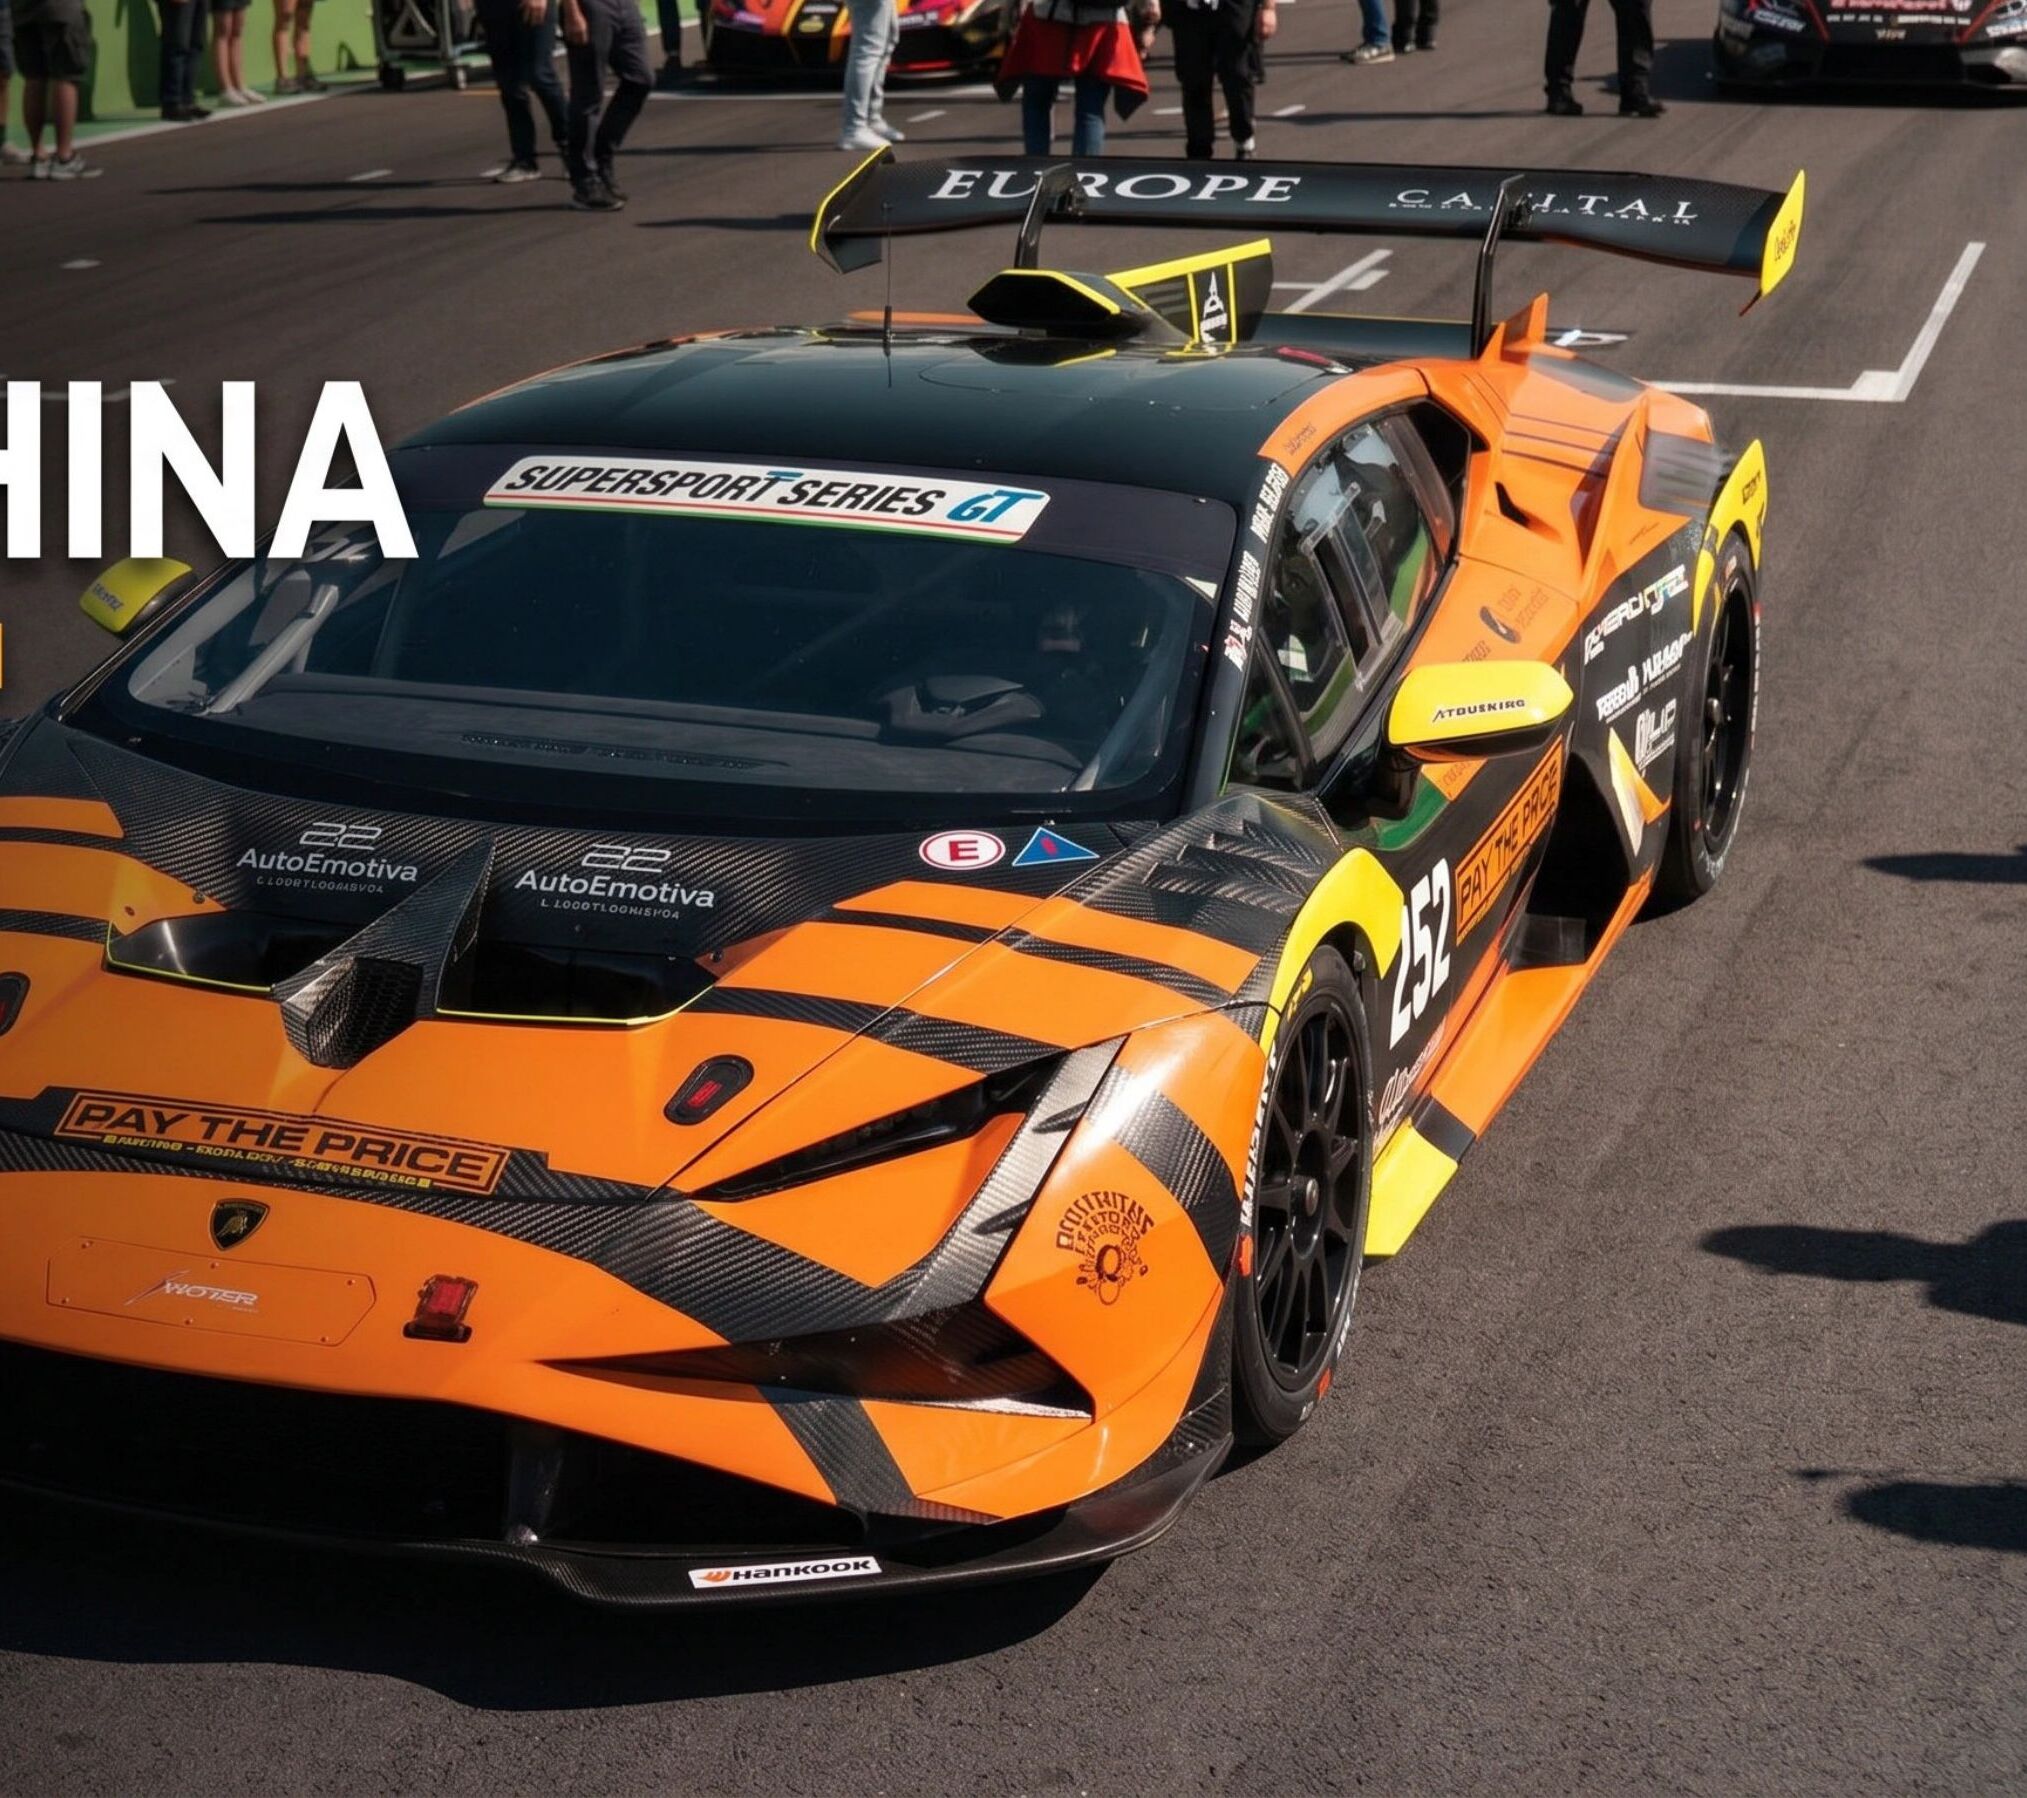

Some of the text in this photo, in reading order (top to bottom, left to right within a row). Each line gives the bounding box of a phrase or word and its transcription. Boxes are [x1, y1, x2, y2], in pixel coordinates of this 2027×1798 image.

[928, 168, 1302, 203] EUROPE
[1397, 189, 1699, 221] CAITAL
[505, 464, 1044, 525] SUPERSPORT SERIES GT
[236, 847, 419, 883] AutoEmotiva
[948, 839, 980, 862] E
[514, 869, 716, 909] AutoEmotiva
[1388, 856, 1453, 1051] 252
[73, 1103, 193, 1135] PAY
[199, 1115, 312, 1152] THE
[311, 1130, 496, 1181] PRICE
